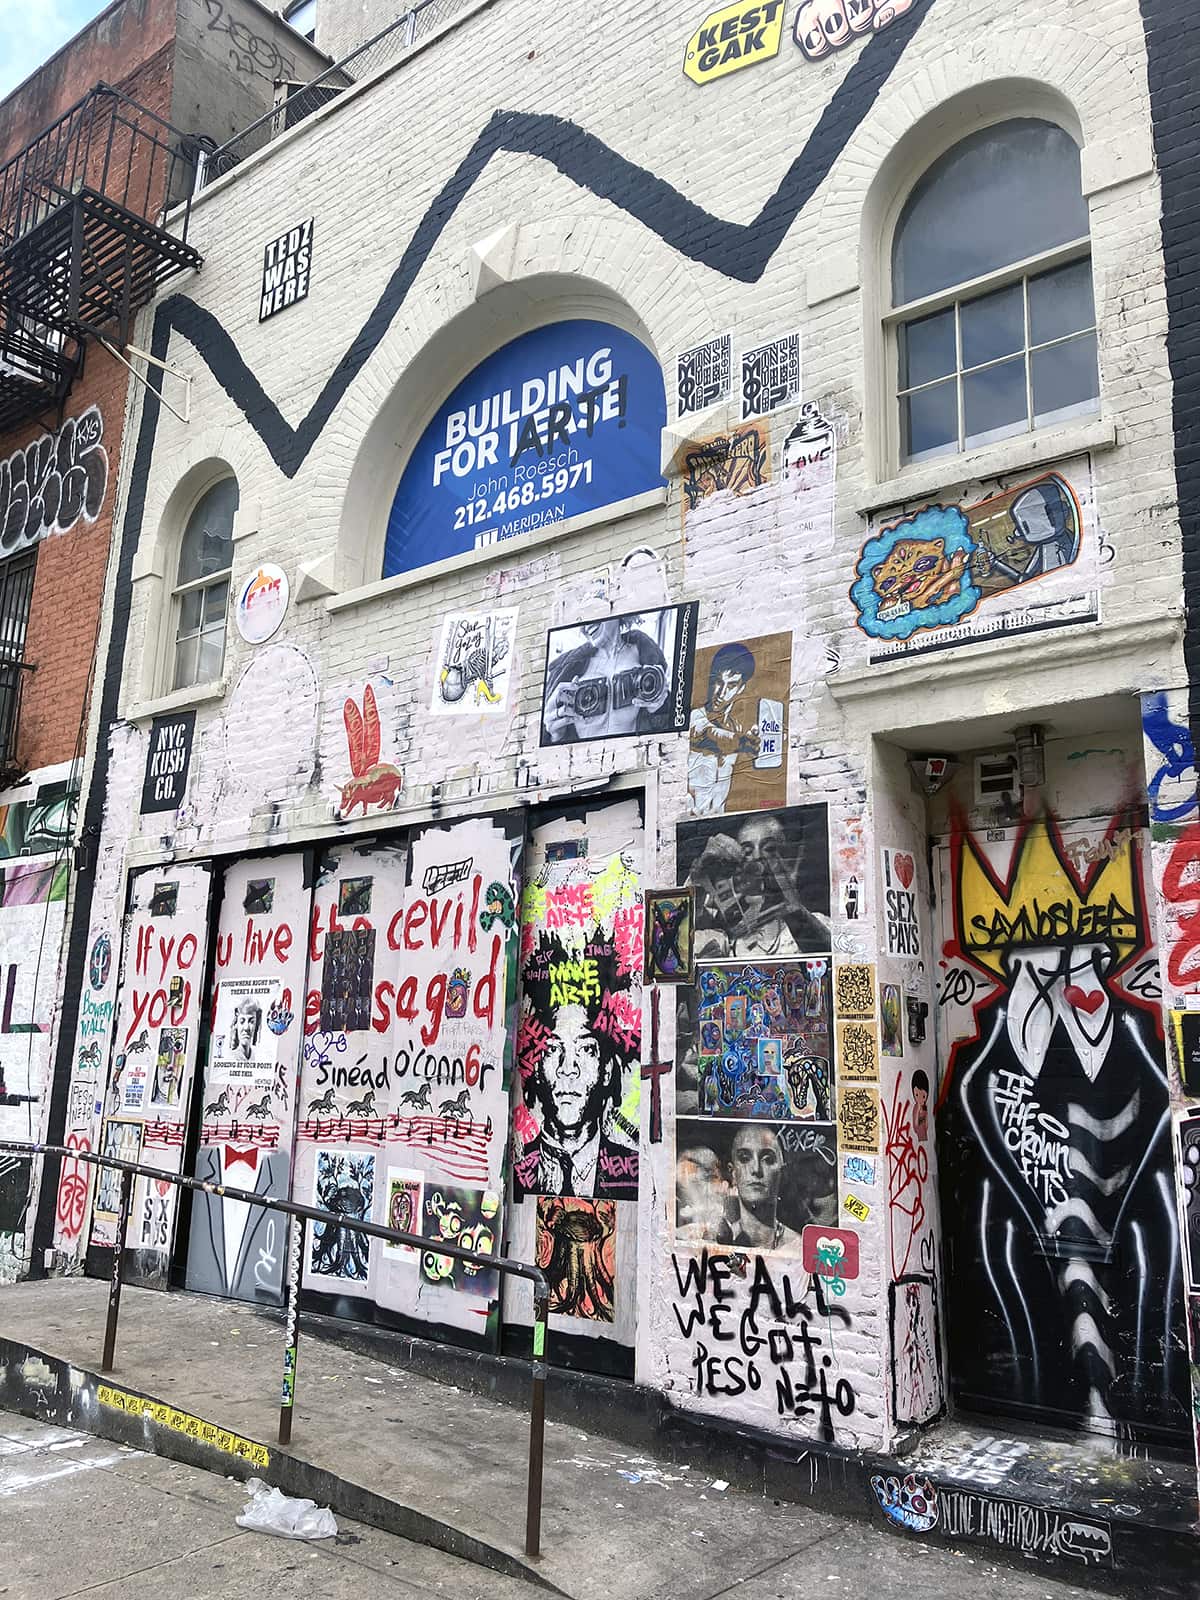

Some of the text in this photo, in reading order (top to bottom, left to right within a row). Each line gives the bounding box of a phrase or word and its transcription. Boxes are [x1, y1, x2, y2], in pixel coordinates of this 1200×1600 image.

[697, 1, 784, 51] KEST
[697, 26, 767, 73] GAK
[266, 220, 312, 269] TEDZ
[265, 247, 309, 293] WAS
[260, 270, 308, 319] HERE
[446, 347, 612, 449] BUILDING
[432, 431, 499, 487] FOR
[468, 447, 579, 501] John Roesch
[453, 459, 593, 530] 212.468.5971
[501, 503, 565, 537] MERIDIAN
[156, 723, 186, 751] NYC
[763, 739, 775, 752] ME
[150, 747, 186, 777] KUSH
[154, 774, 177, 800] CO.
[886, 888, 919, 924] SEX
[135, 924, 154, 977] If
[243, 918, 293, 966] live
[888, 921, 920, 956] PAYS
[548, 958, 599, 984] MAKE
[548, 981, 600, 1007] ART!
[80, 1018, 106, 1037] WALL
[994, 1095, 1040, 1132] THE
[144, 1198, 170, 1222] SX
[671, 1247, 852, 1331] WE ALL
[672, 1293, 736, 1340] WE
[692, 1340, 762, 1397] PESO
